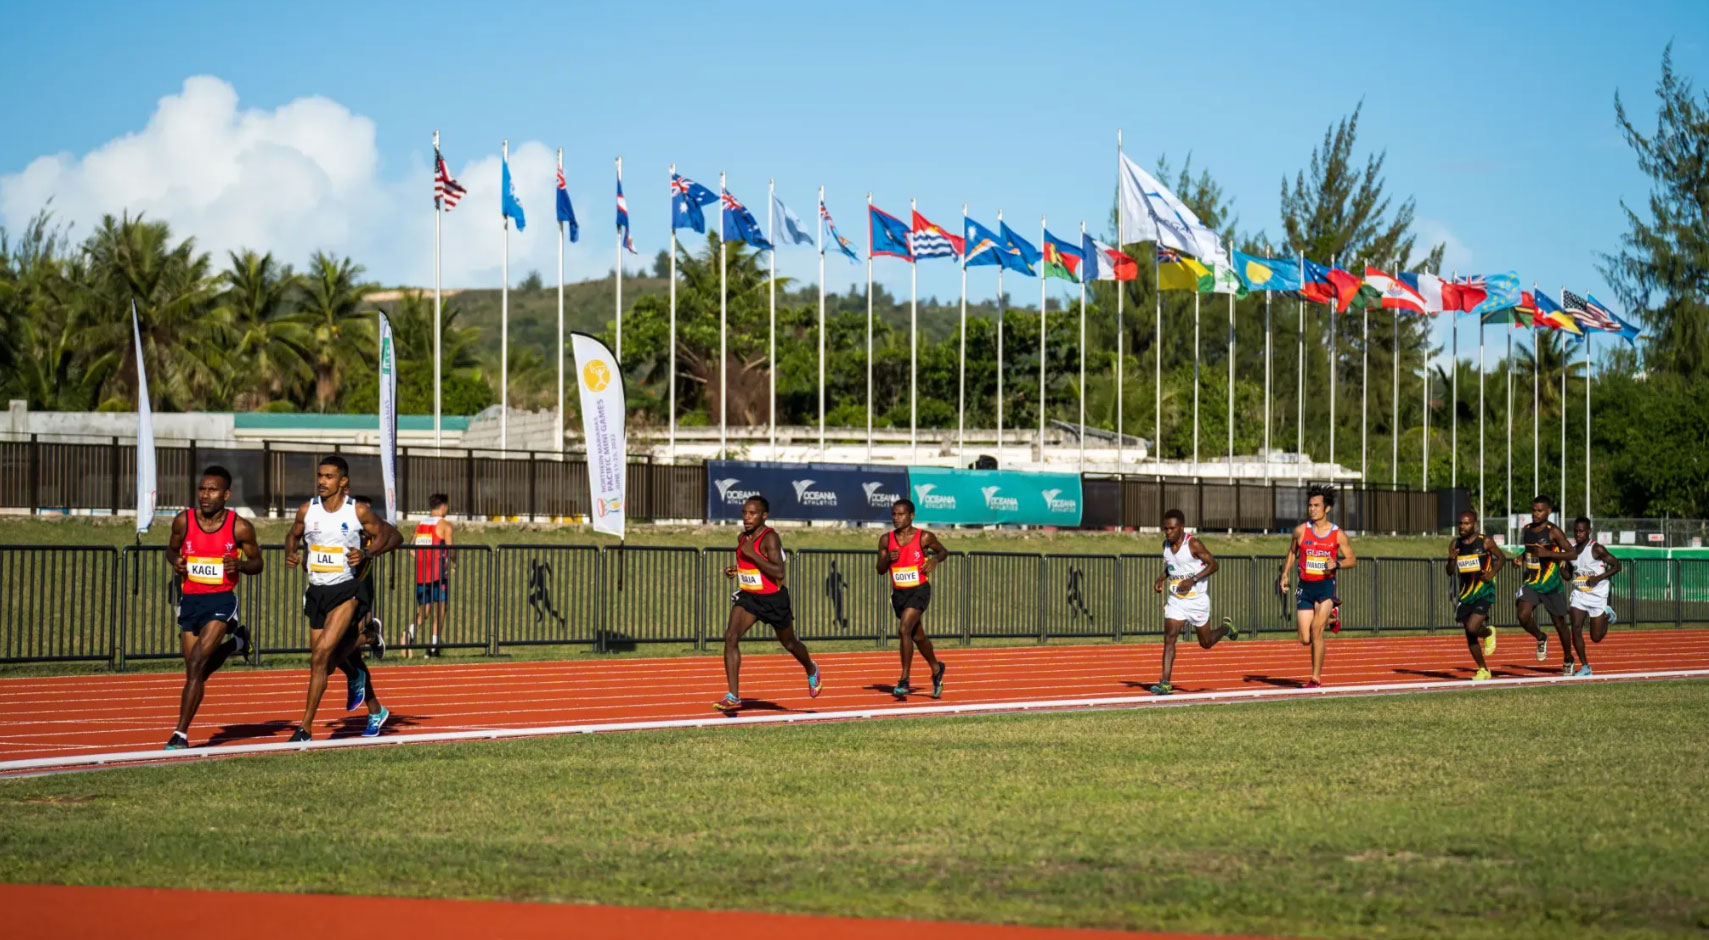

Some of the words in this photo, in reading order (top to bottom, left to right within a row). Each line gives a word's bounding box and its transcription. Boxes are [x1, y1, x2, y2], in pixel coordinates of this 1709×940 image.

[596, 398, 607, 432] GAMES
[593, 416, 603, 454] MARIANAS
[602, 433, 610, 455] MINI
[598, 455, 607, 493] NORTHERN
[604, 456, 614, 492] PACIFIC
[614, 473, 622, 490] JUNE
[803, 491, 837, 500] OCEANIA
[872, 493, 901, 502] OCEANIA
[925, 494, 956, 503] OCEANIA
[990, 496, 1018, 506] OCEANIA
[1051, 499, 1077, 507] OCEANIA
[1305, 548, 1331, 557] GUAM
[317, 554, 334, 564] LAL
[192, 565, 218, 576] KAGL
[895, 572, 916, 581] GOIYE
